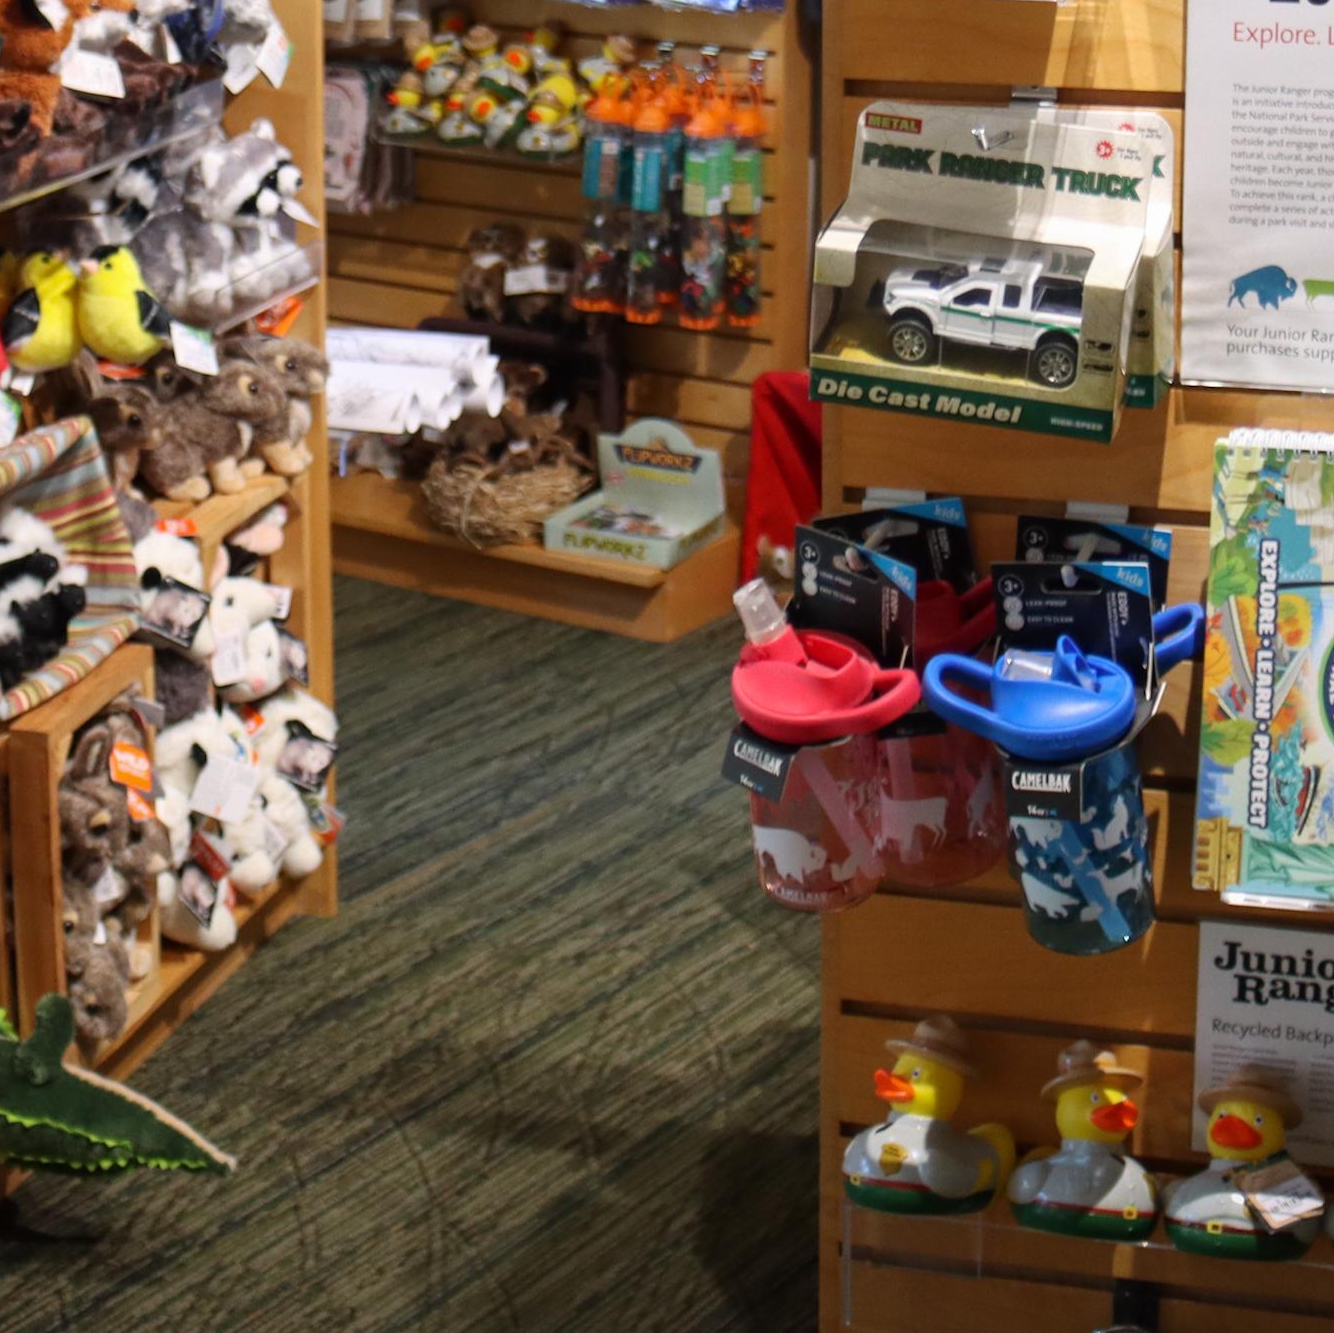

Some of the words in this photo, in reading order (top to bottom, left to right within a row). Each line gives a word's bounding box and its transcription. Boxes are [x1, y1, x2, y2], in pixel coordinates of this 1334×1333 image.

[1232, 21, 1321, 49] Explore.
[1233, 84, 1249, 92] The
[1252, 84, 1278, 94] Junior
[1281, 86, 1311, 97] Ranger
[867, 115, 918, 132] METAL
[862, 141, 935, 174] PARK
[939, 151, 1046, 190] RANGER
[1051, 166, 1144, 202] TRUCK
[1227, 324, 1259, 339] Your
[1262, 325, 1307, 342] Junior
[1226, 341, 1299, 360] purchases
[818, 377, 863, 400] Die
[868, 382, 929, 411] Cast
[935, 394, 1022, 424] Model
[1029, 532, 1043, 545] 3+
[804, 546, 816, 558] 3+
[891, 566, 911, 589] kids
[1003, 580, 1018, 593] 3+
[1116, 567, 1144, 587] kids
[1256, 538, 1279, 637] EXPLORE
[1252, 649, 1275, 721] LEARN
[733, 739, 783, 776] CAMELBAK
[1011, 771, 1071, 794] CAMELBAK
[1247, 732, 1271, 829] PROTECT
[1211, 1018, 1281, 1040] Recycled
